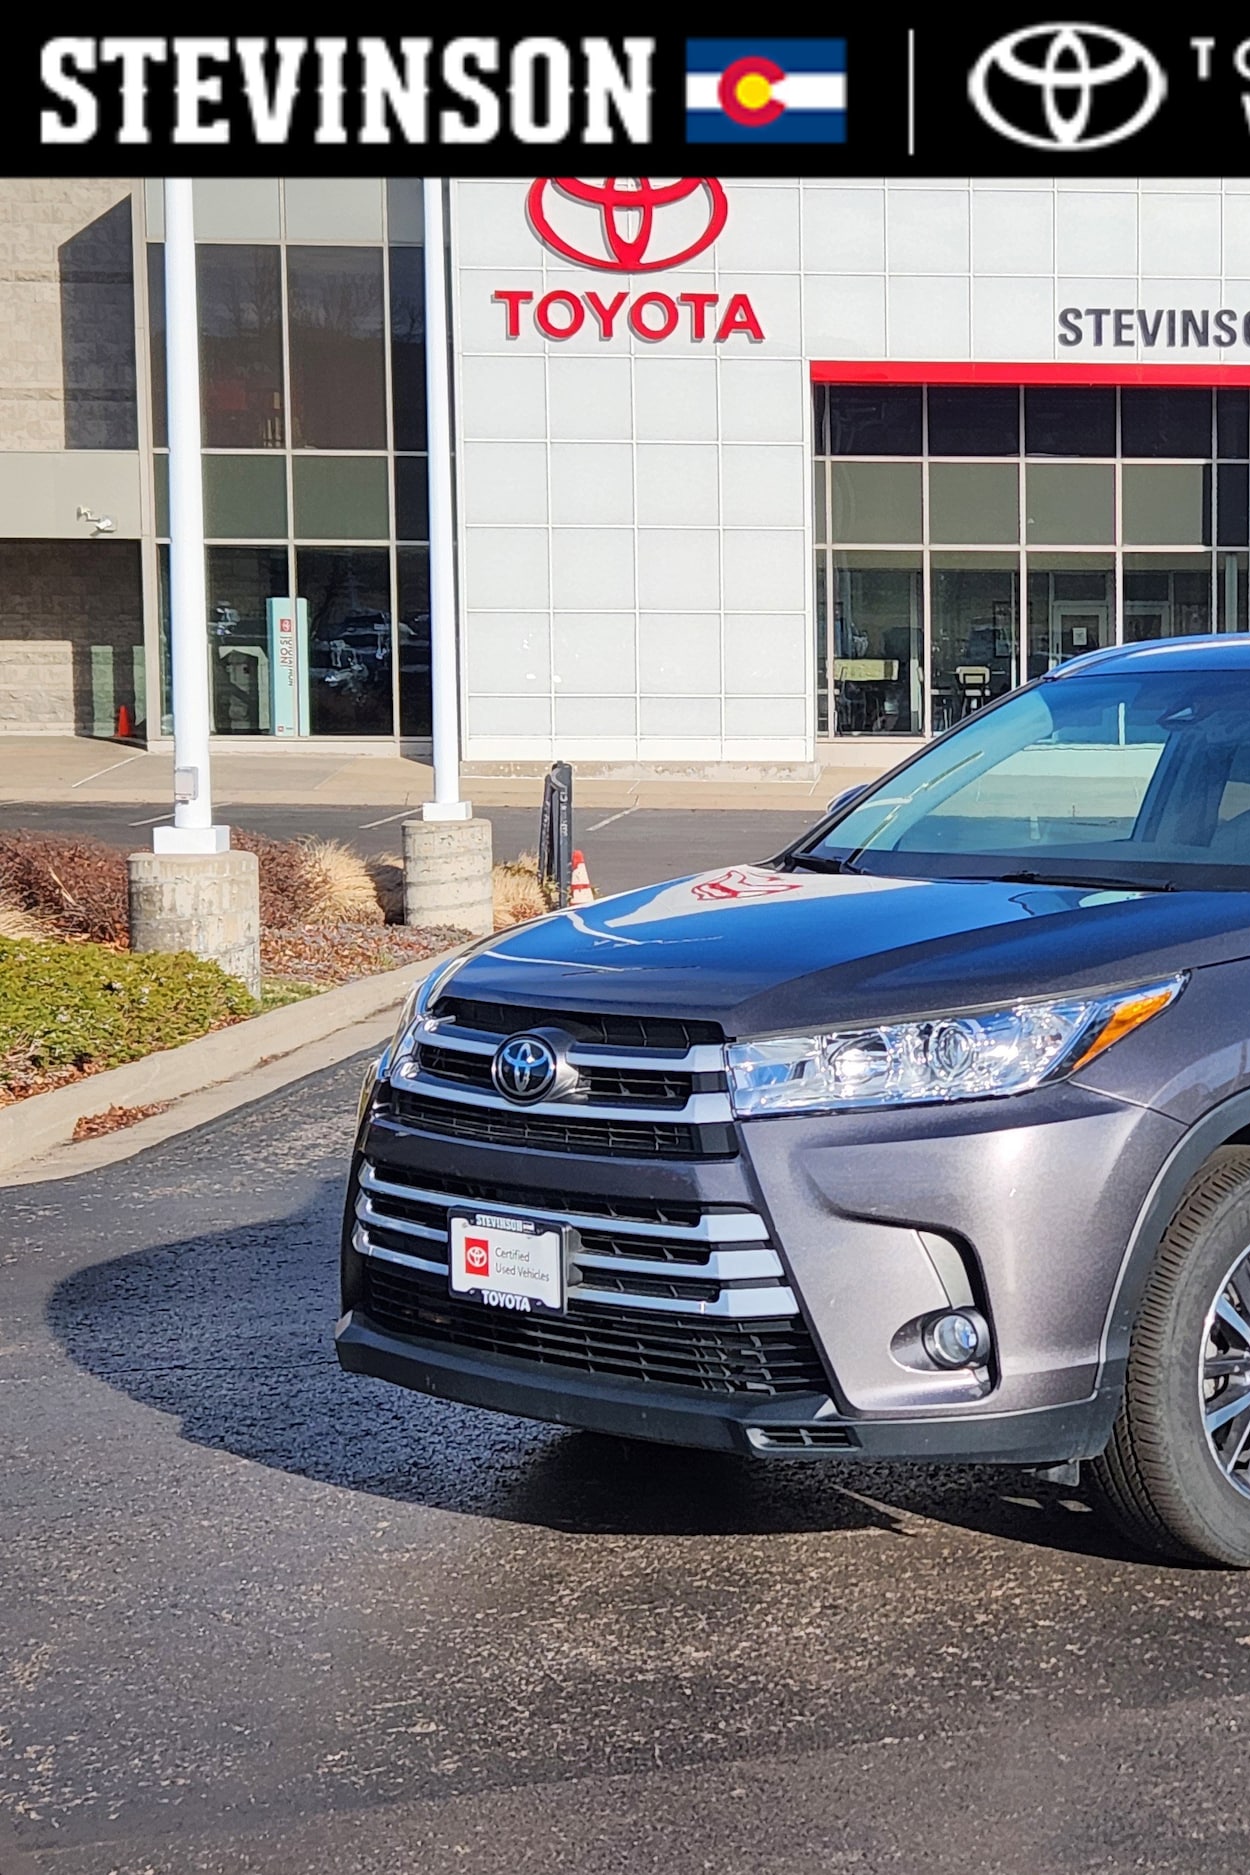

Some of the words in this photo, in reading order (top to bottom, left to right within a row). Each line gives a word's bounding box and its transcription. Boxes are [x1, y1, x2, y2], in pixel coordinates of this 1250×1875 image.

[493, 290, 766, 341] TOYOTA
[495, 1247, 530, 1262] Certified
[495, 1262, 516, 1275] Used
[517, 1265, 550, 1282] Vehicles
[481, 1290, 531, 1313] TOYOTA
